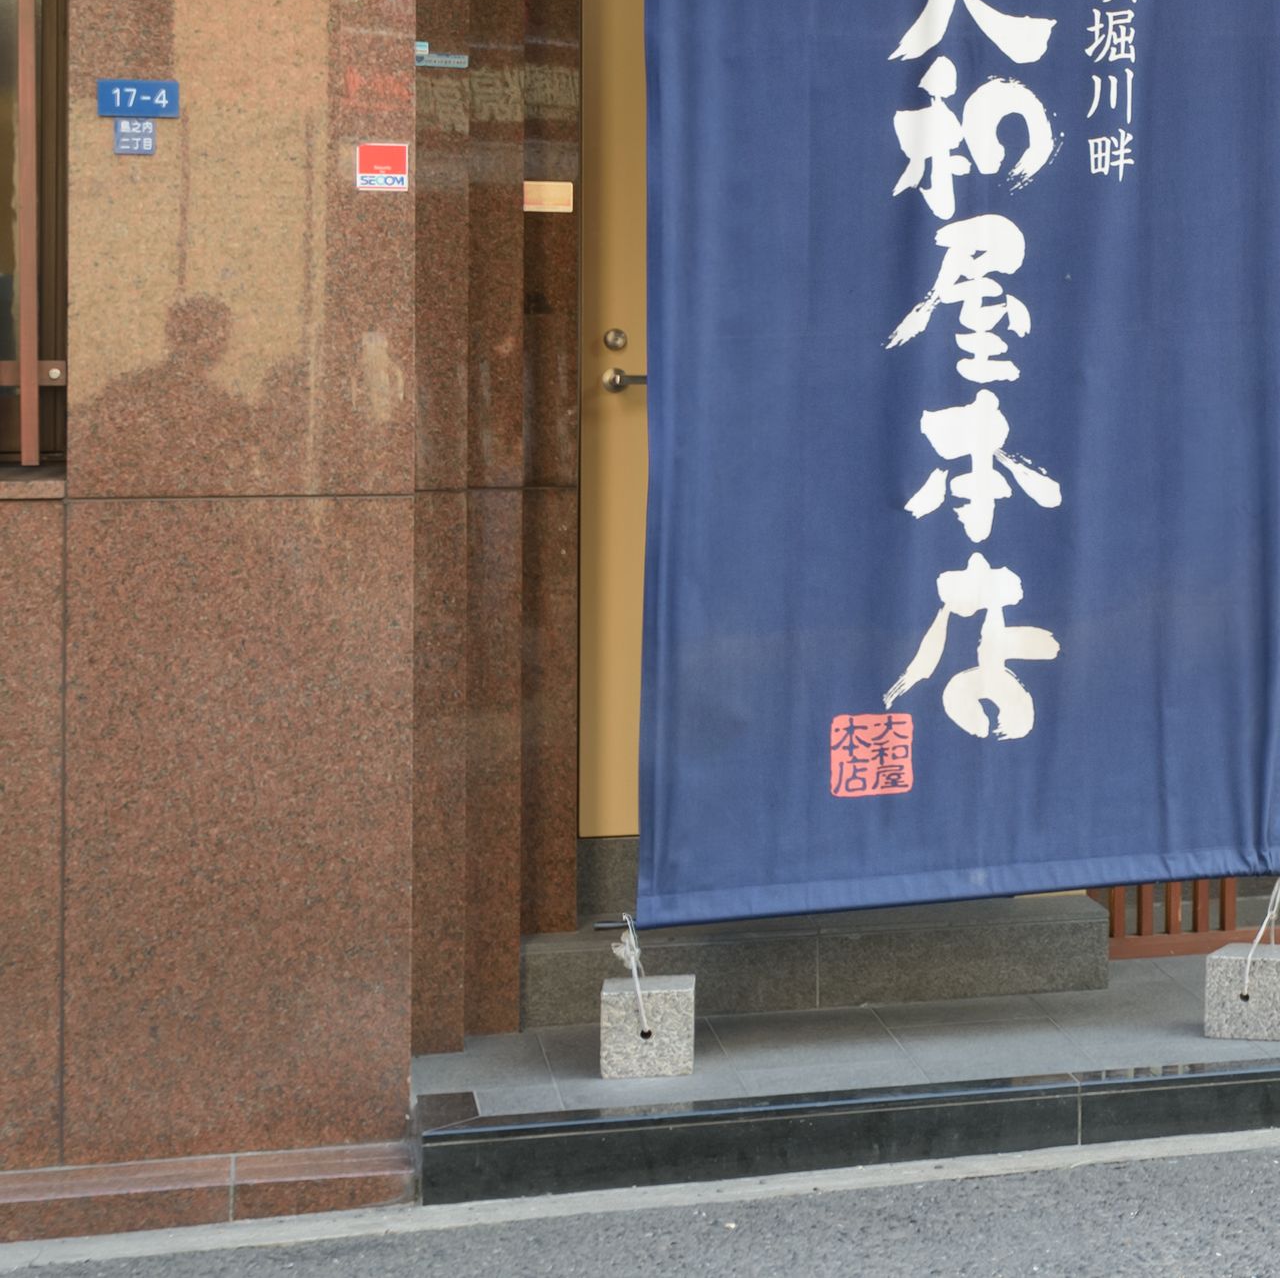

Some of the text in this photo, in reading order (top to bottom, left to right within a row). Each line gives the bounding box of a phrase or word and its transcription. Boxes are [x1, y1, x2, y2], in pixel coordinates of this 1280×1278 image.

[111, 87, 169, 108] 17-4
[120, 137, 153, 150] 二丁目
[360, 175, 404, 186] SECOM
[831, 717, 871, 794] 本店
[870, 714, 912, 790] 大和屋
